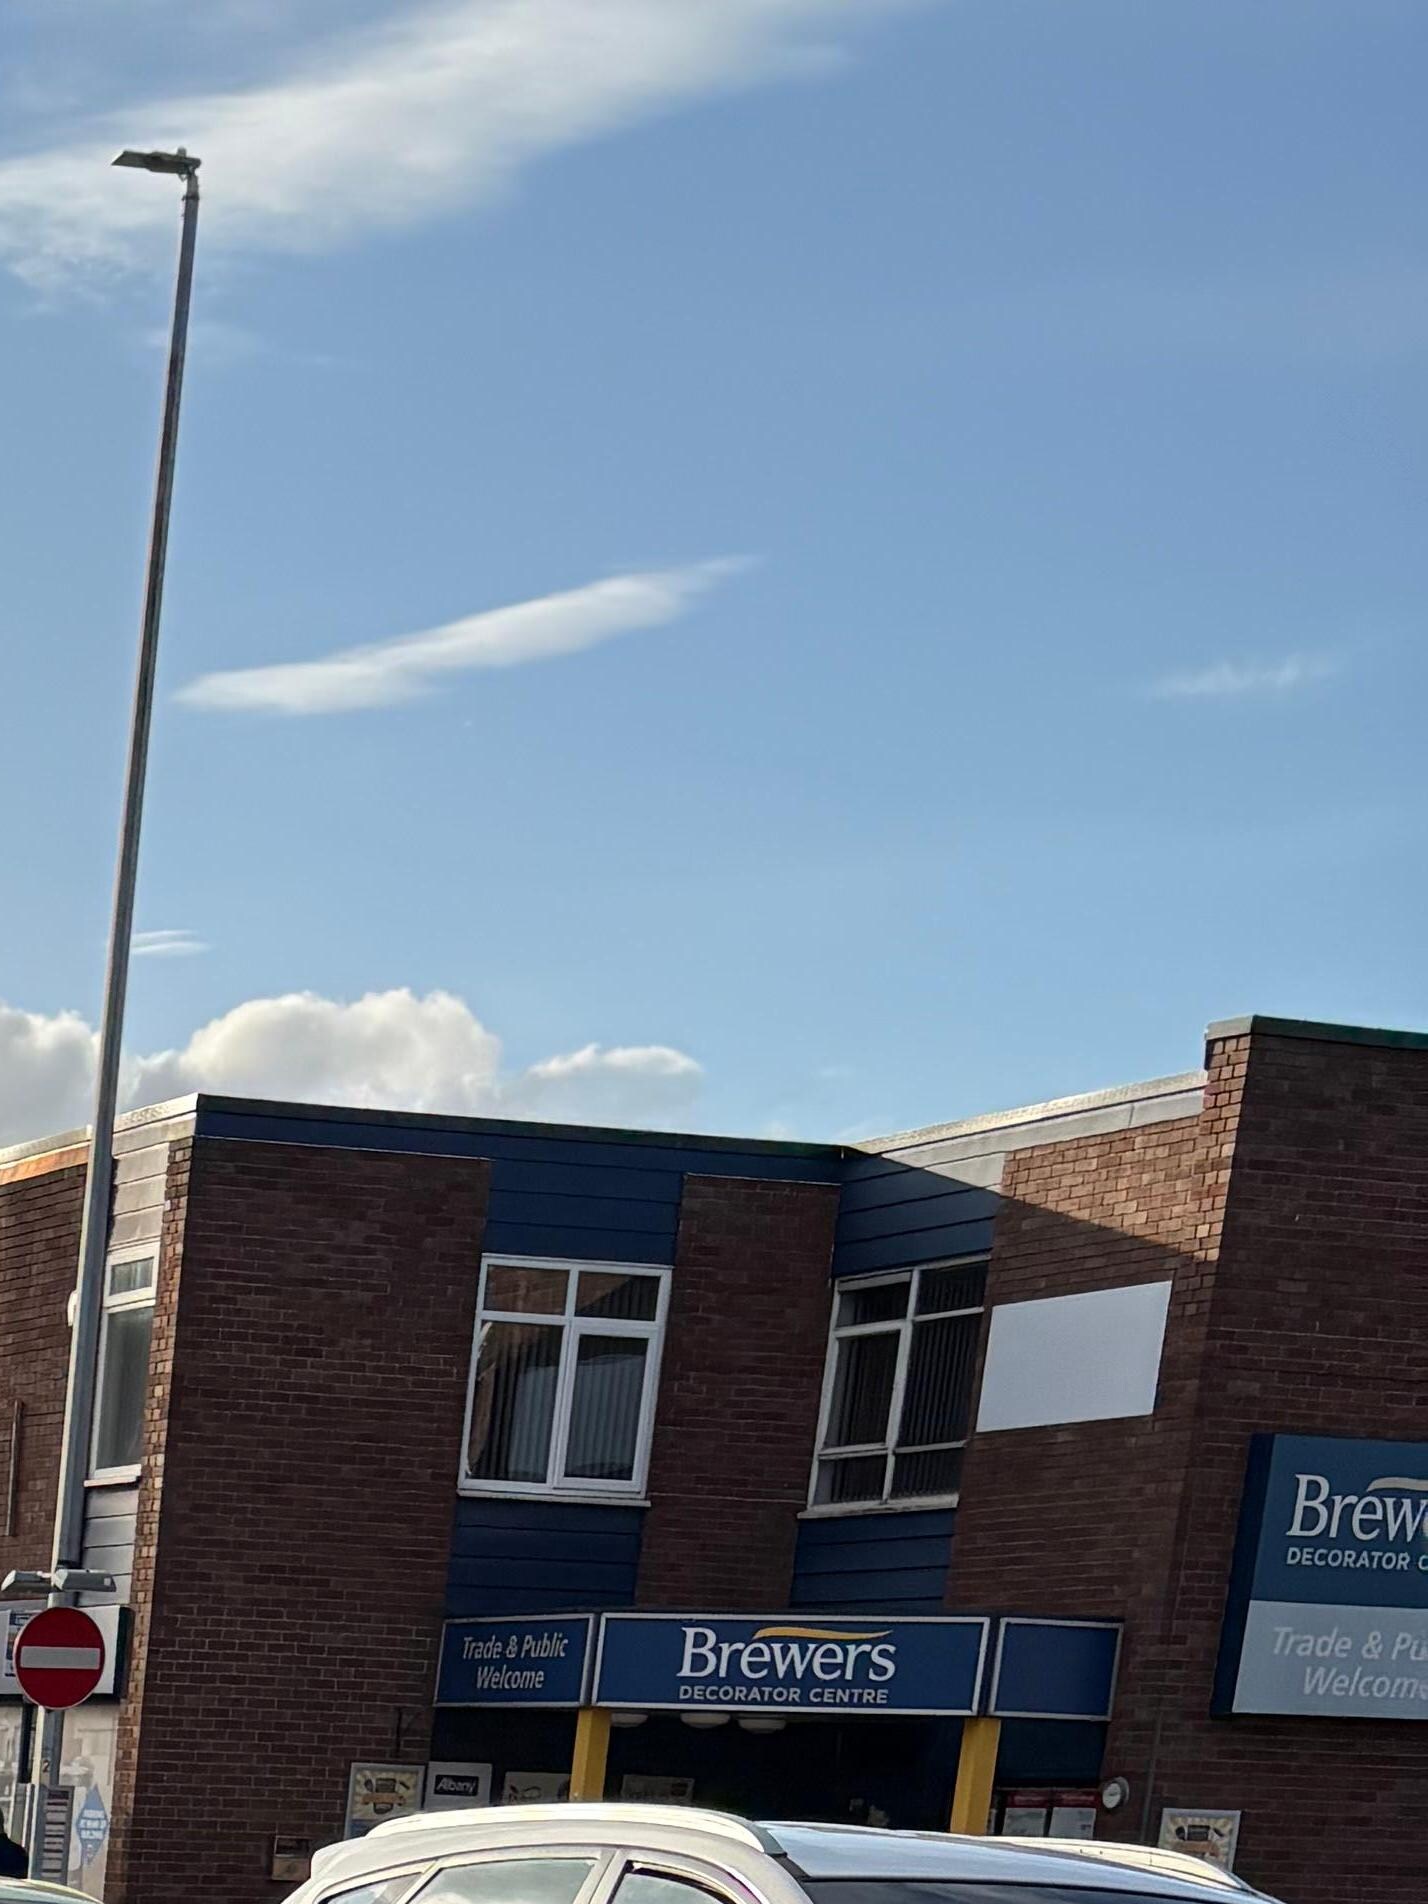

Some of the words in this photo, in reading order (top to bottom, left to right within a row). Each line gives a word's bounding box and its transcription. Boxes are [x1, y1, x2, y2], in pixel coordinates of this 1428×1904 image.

[1286, 1473, 1428, 1543] Brew
[1286, 1547, 1411, 1571] DECORATOR
[462, 1634, 503, 1659] Trade
[505, 1635, 518, 1658] &
[520, 1632, 569, 1659] Public
[676, 1625, 897, 1681] Brewers
[1272, 1626, 1352, 1659] Trade
[1361, 1630, 1383, 1660] &
[476, 1664, 545, 1689] Welcome
[679, 1684, 801, 1703] DECORATOR
[809, 1687, 889, 1704] CENTRE
[435, 1776, 477, 1793] Albany
